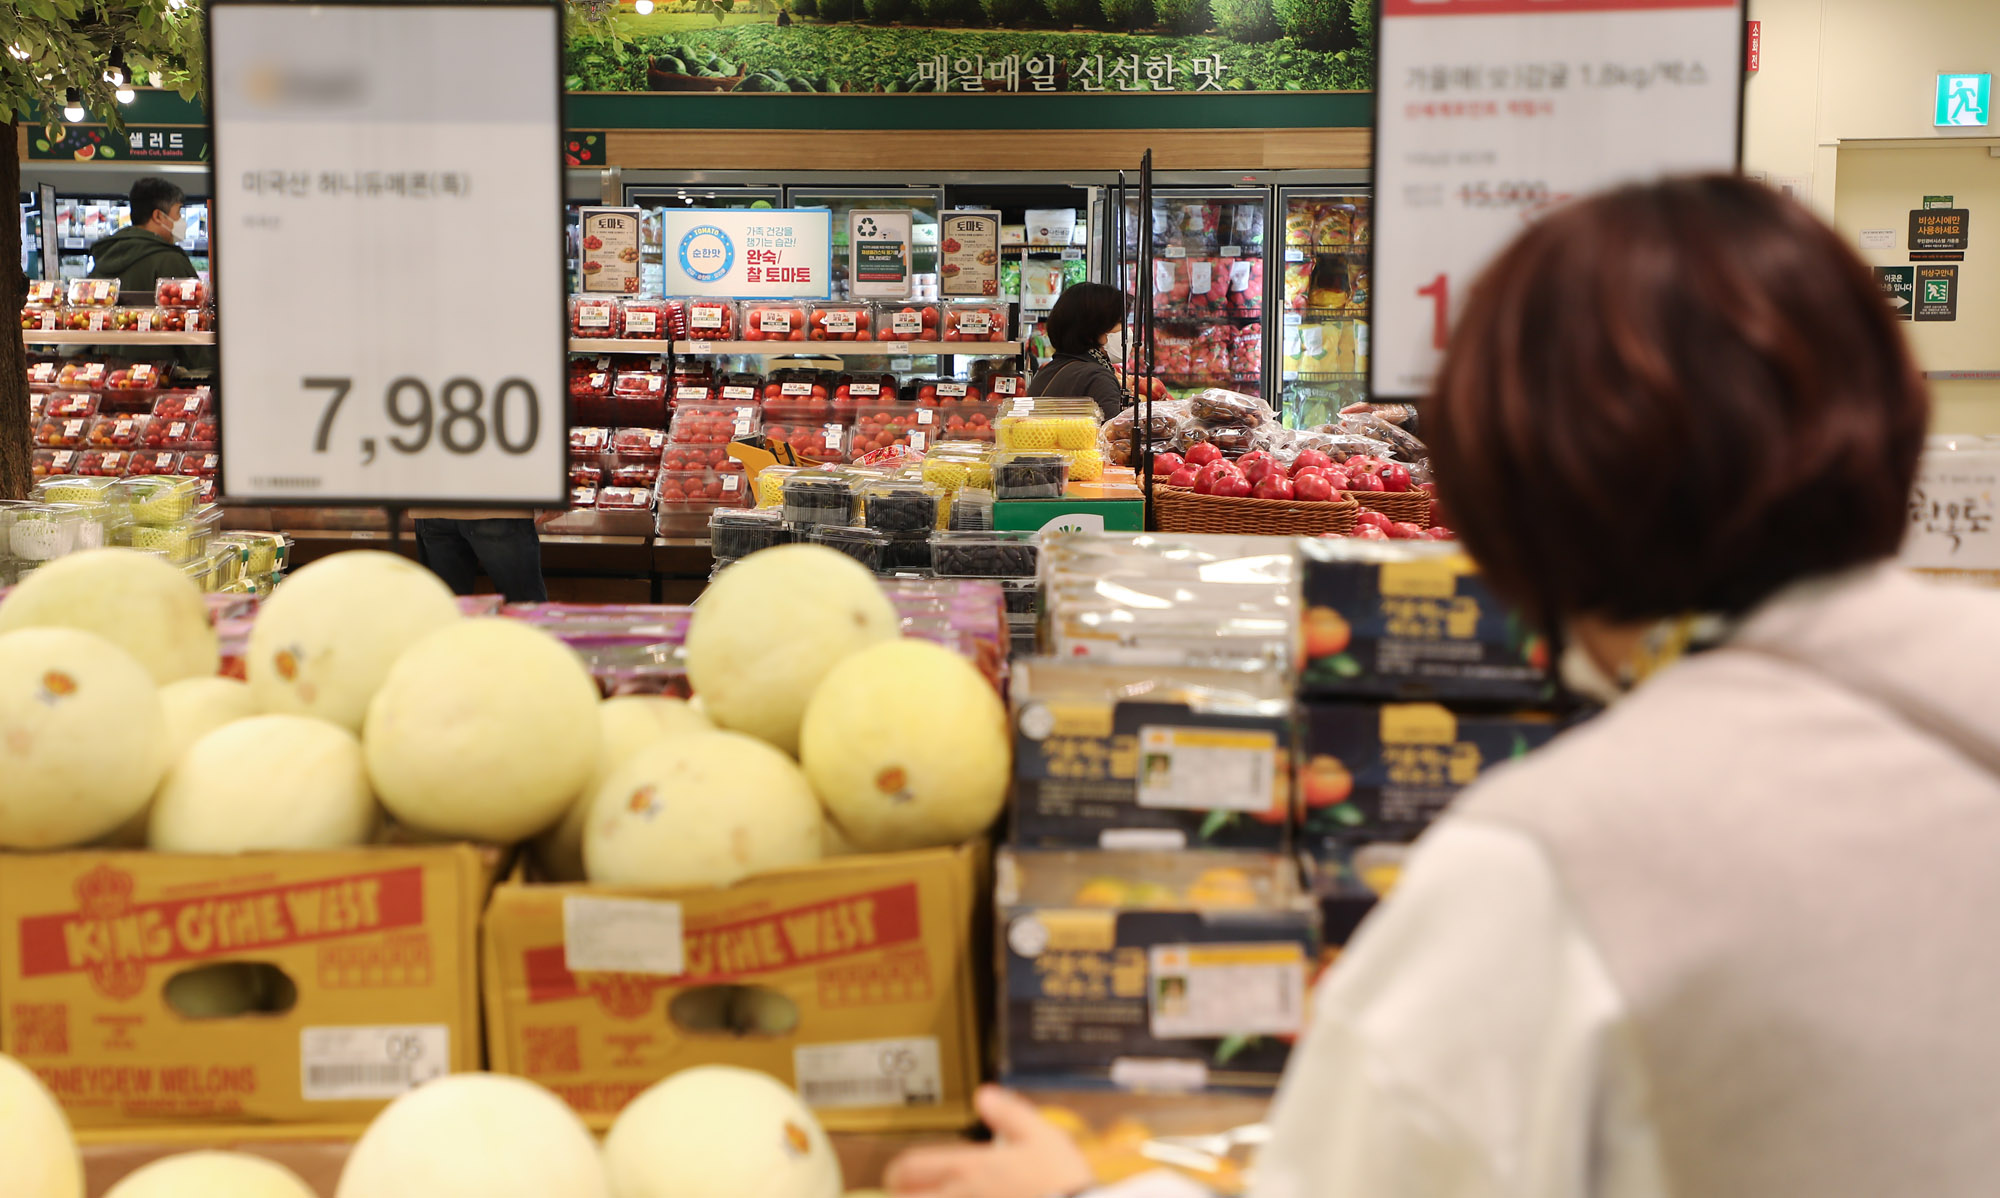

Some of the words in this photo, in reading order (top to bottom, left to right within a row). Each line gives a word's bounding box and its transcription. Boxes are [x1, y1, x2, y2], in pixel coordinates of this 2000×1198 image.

[1750, 23, 1760, 70] 소화전
[917, 54, 1057, 93] 매일매일
[1072, 54, 1180, 92] 신선한
[1191, 54, 1229, 92] 맛
[129, 132, 184, 149] 샐러드
[242, 170, 311, 197] 미국산
[598, 218, 626, 230] 토마토
[956, 220, 985, 232] 토마토
[1918, 215, 1961, 225] 비상시에만
[693, 227, 720, 236] TOMATO
[746, 226, 764, 237] 가족
[766, 226, 793, 237] 건강을
[1917, 225, 1960, 236] 사용하세요
[746, 237, 774, 248] 챙기는
[775, 237, 797, 248] 습관!
[692, 248, 721, 258] 순한맛
[747, 249, 783, 265] 완숙/
[746, 267, 763, 283] 찰
[765, 267, 811, 283] 토마토
[1884, 273, 1903, 283] 이곳은
[1921, 268, 1954, 278] 비상구안내
[1893, 283, 1912, 292] 입니다
[302, 376, 541, 466] 7,980
[62, 909, 174, 967] KING
[285, 876, 381, 936] WEST
[780, 898, 877, 958] WEST
[159, 1065, 257, 1094] MELONS
